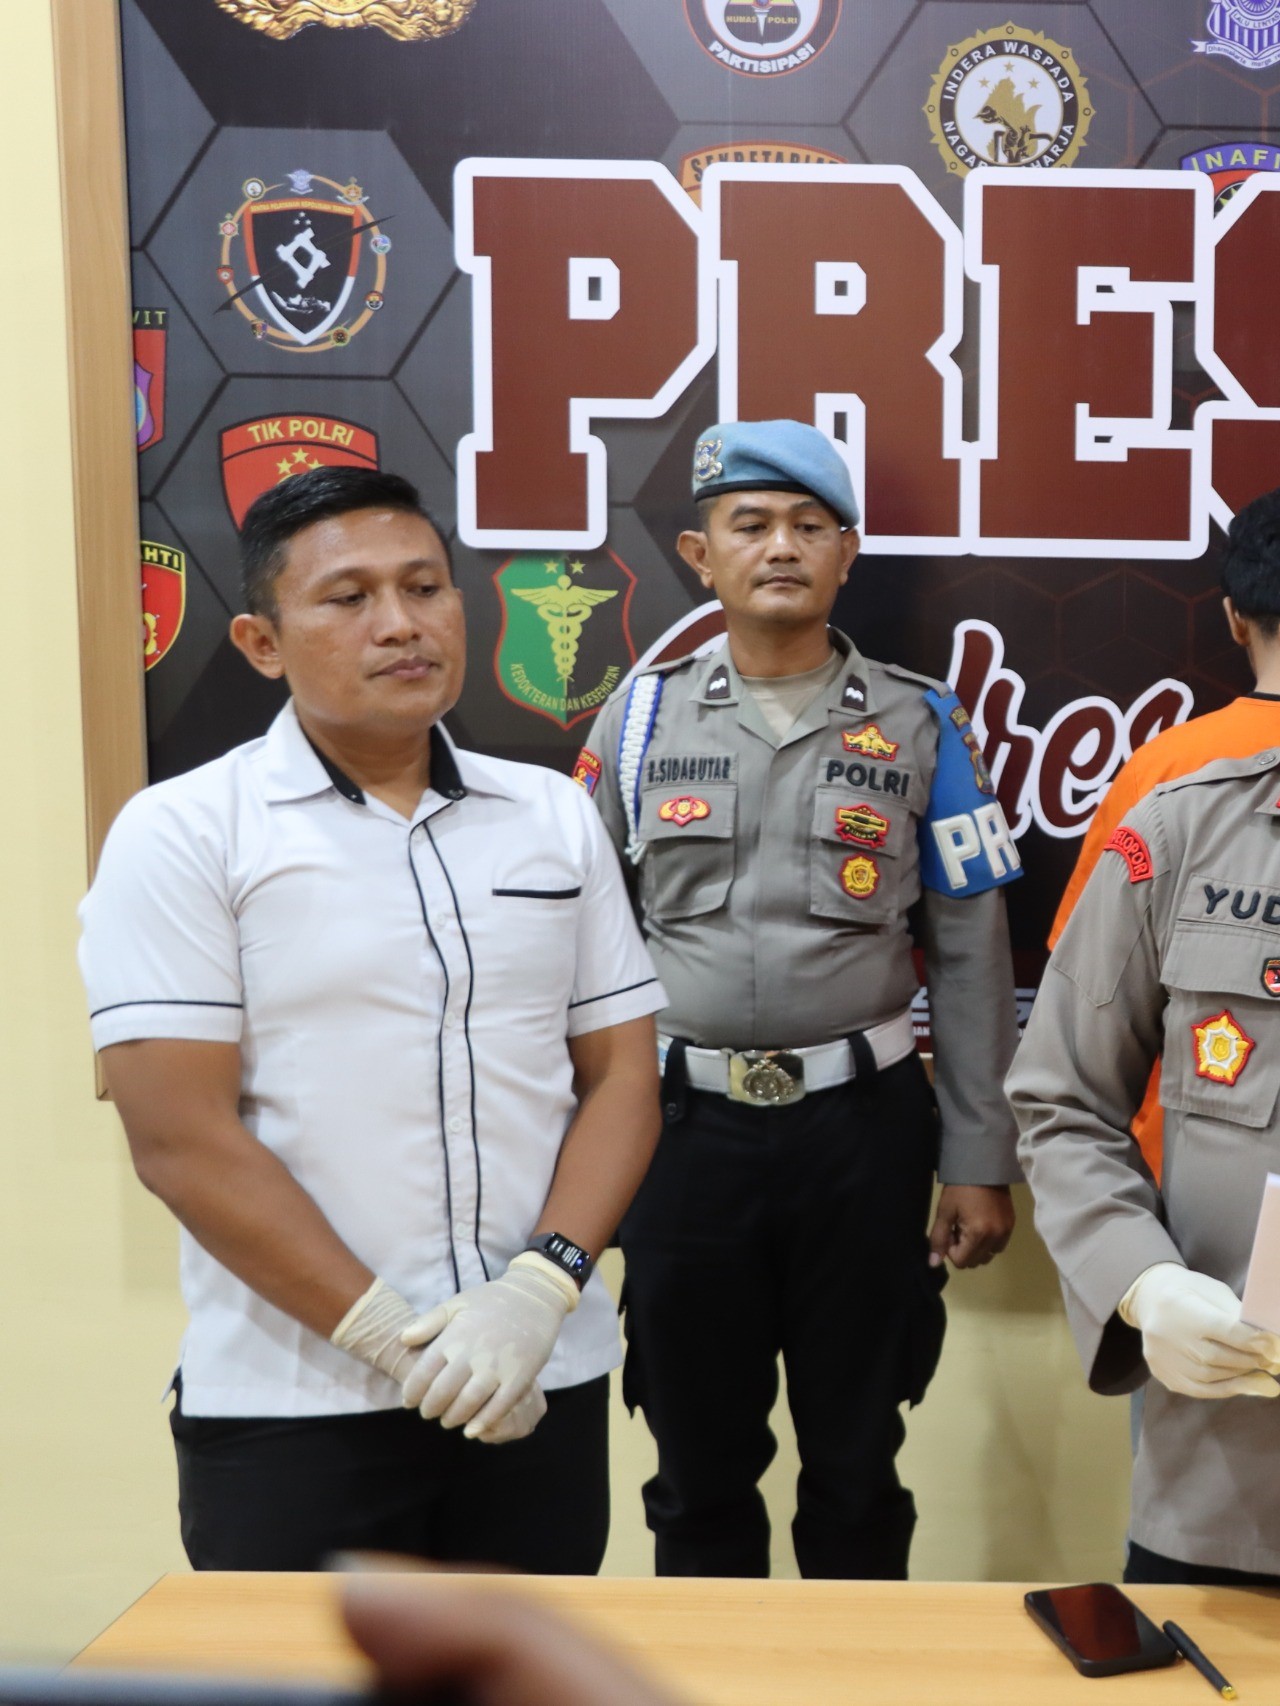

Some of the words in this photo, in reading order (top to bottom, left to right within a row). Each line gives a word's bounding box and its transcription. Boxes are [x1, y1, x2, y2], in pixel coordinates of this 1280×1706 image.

[767, 17, 798, 25] POLRI
[708, 40, 817, 74] PARTISIPASI
[943, 45, 997, 100] INDERA
[1004, 41, 1075, 103] WASPADA
[247, 420, 285, 443] TIK
[289, 419, 355, 446] POLRI
[143, 546, 179, 569] HTI
[580, 665, 621, 711] KESEHATAN
[826, 759, 910, 797] POLRI
